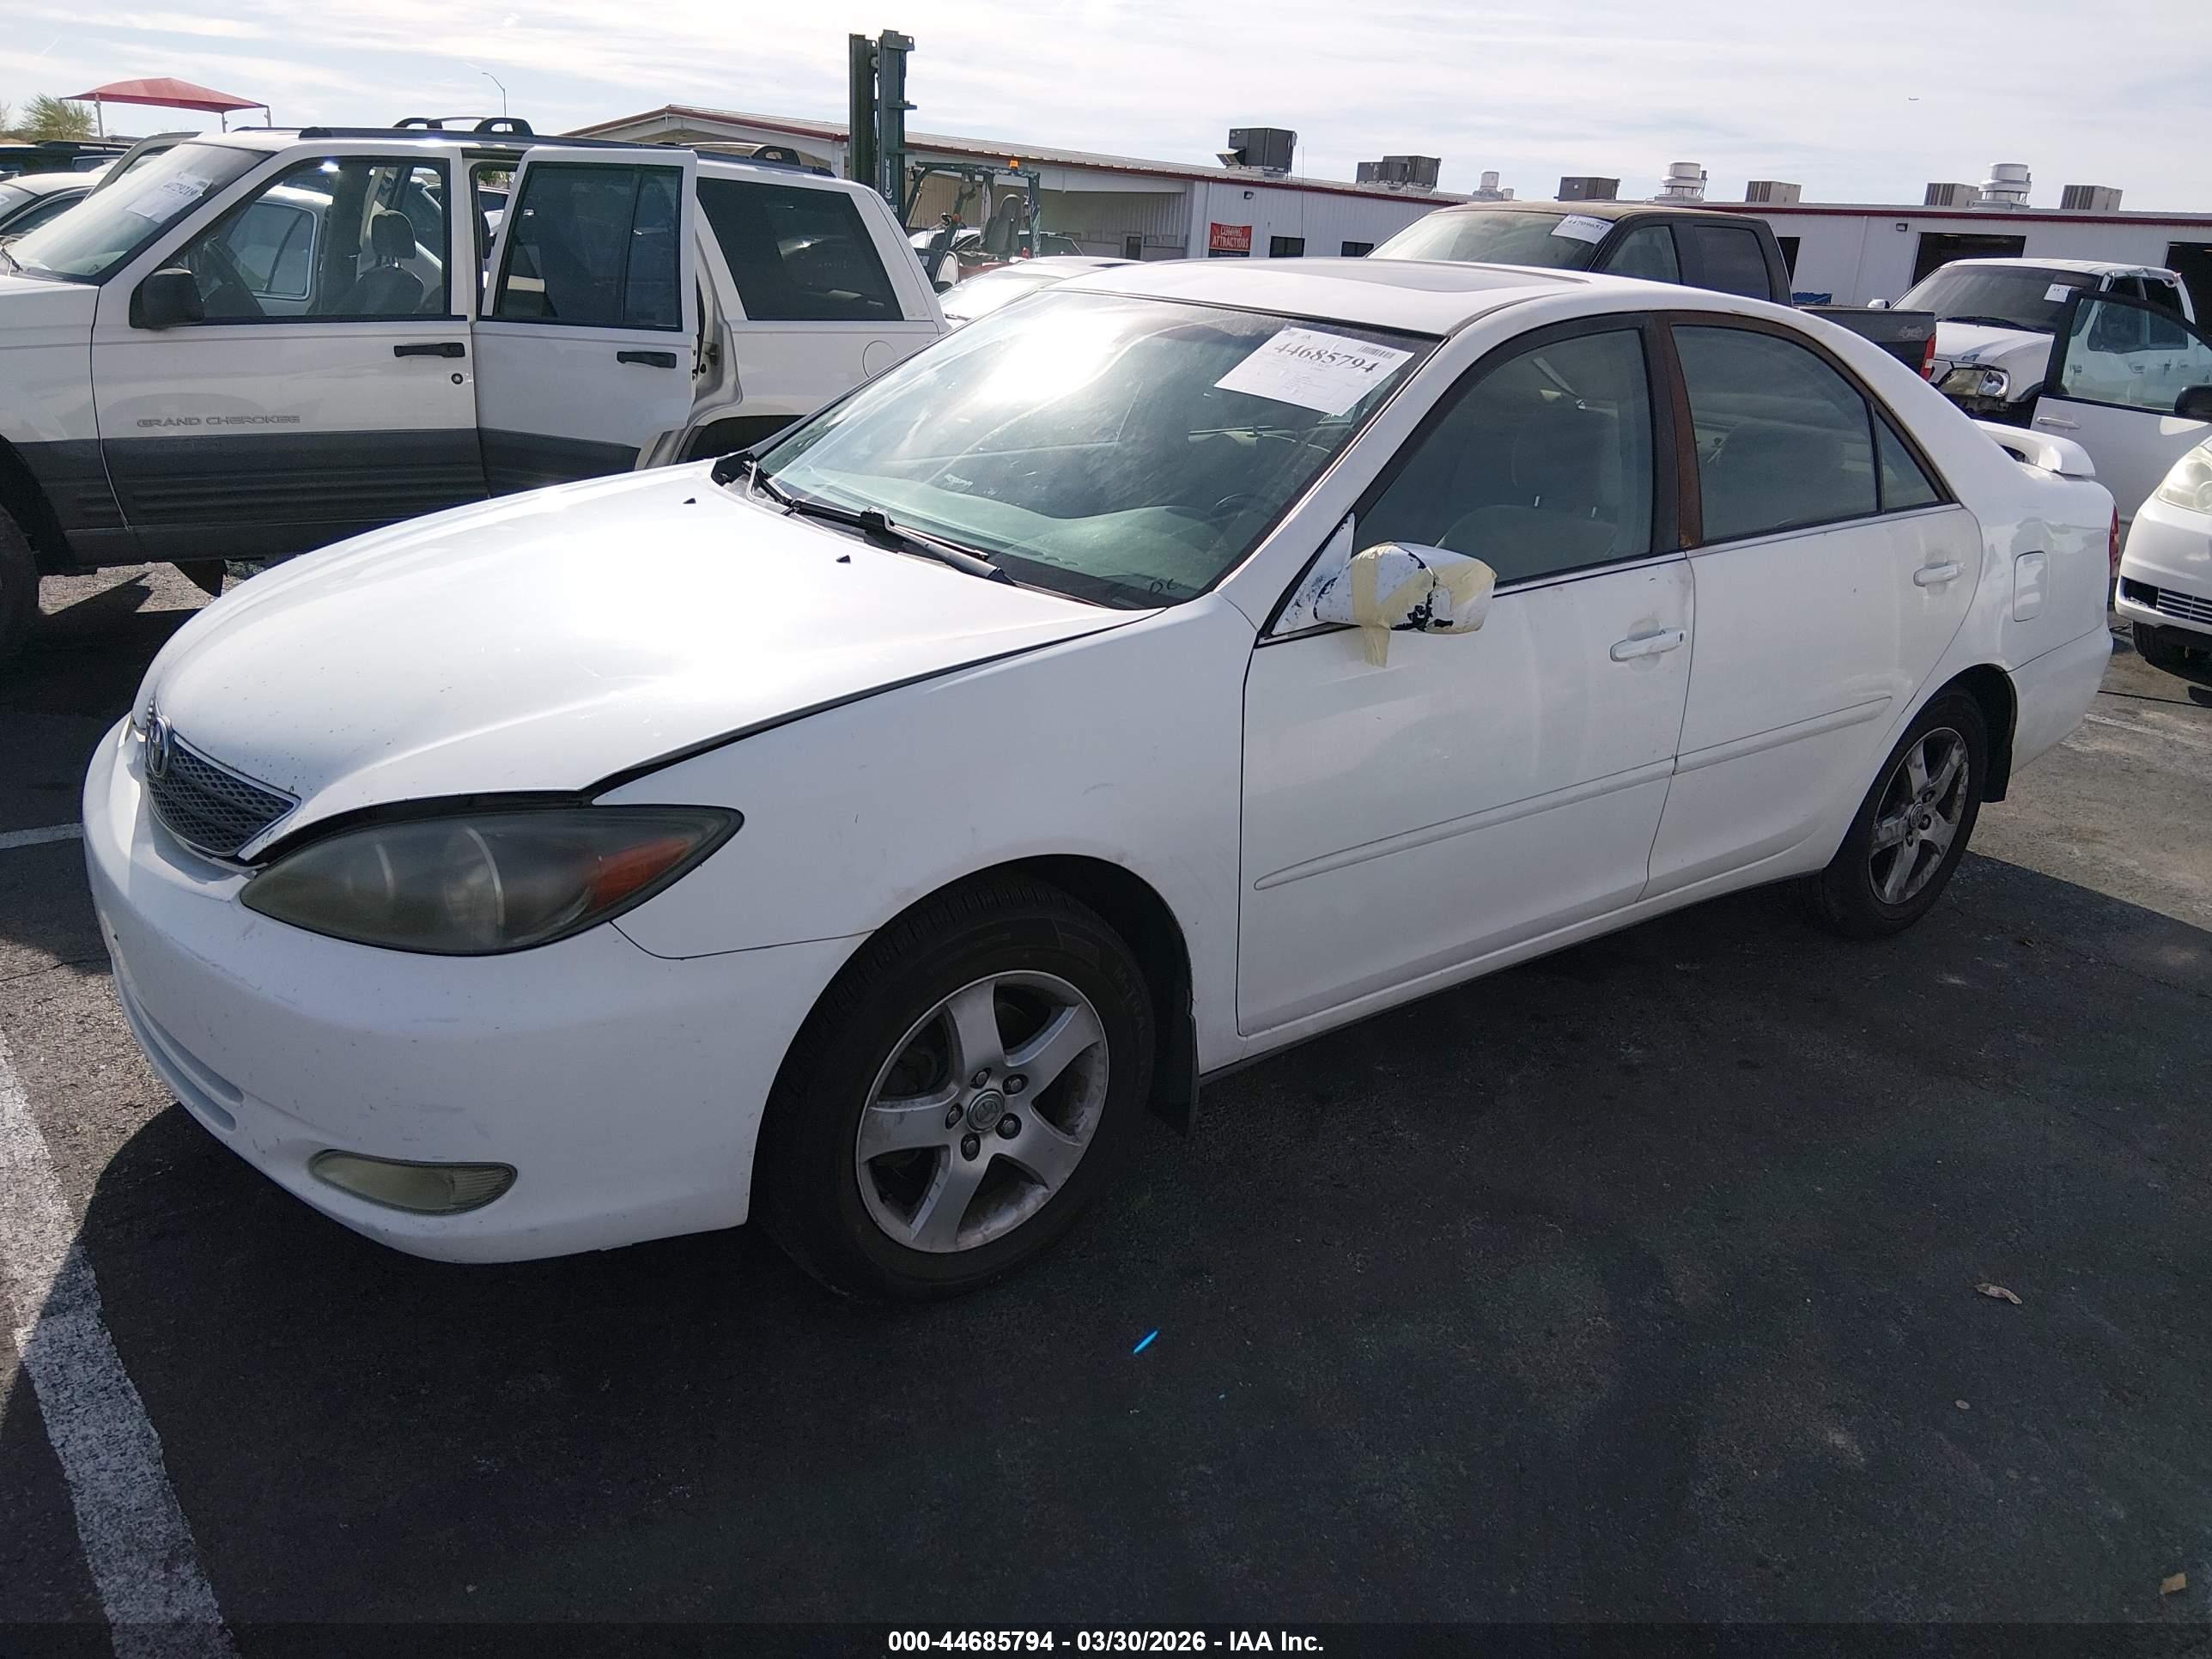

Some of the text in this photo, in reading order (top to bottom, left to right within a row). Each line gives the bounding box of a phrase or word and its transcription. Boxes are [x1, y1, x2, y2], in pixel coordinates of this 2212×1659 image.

[1220, 226, 1243, 237] COMING
[1212, 235, 1249, 248] ATTRACTIONS
[1273, 342, 1380, 374] 44685794
[137, 416, 301, 428] GRAND CHEROKEE
